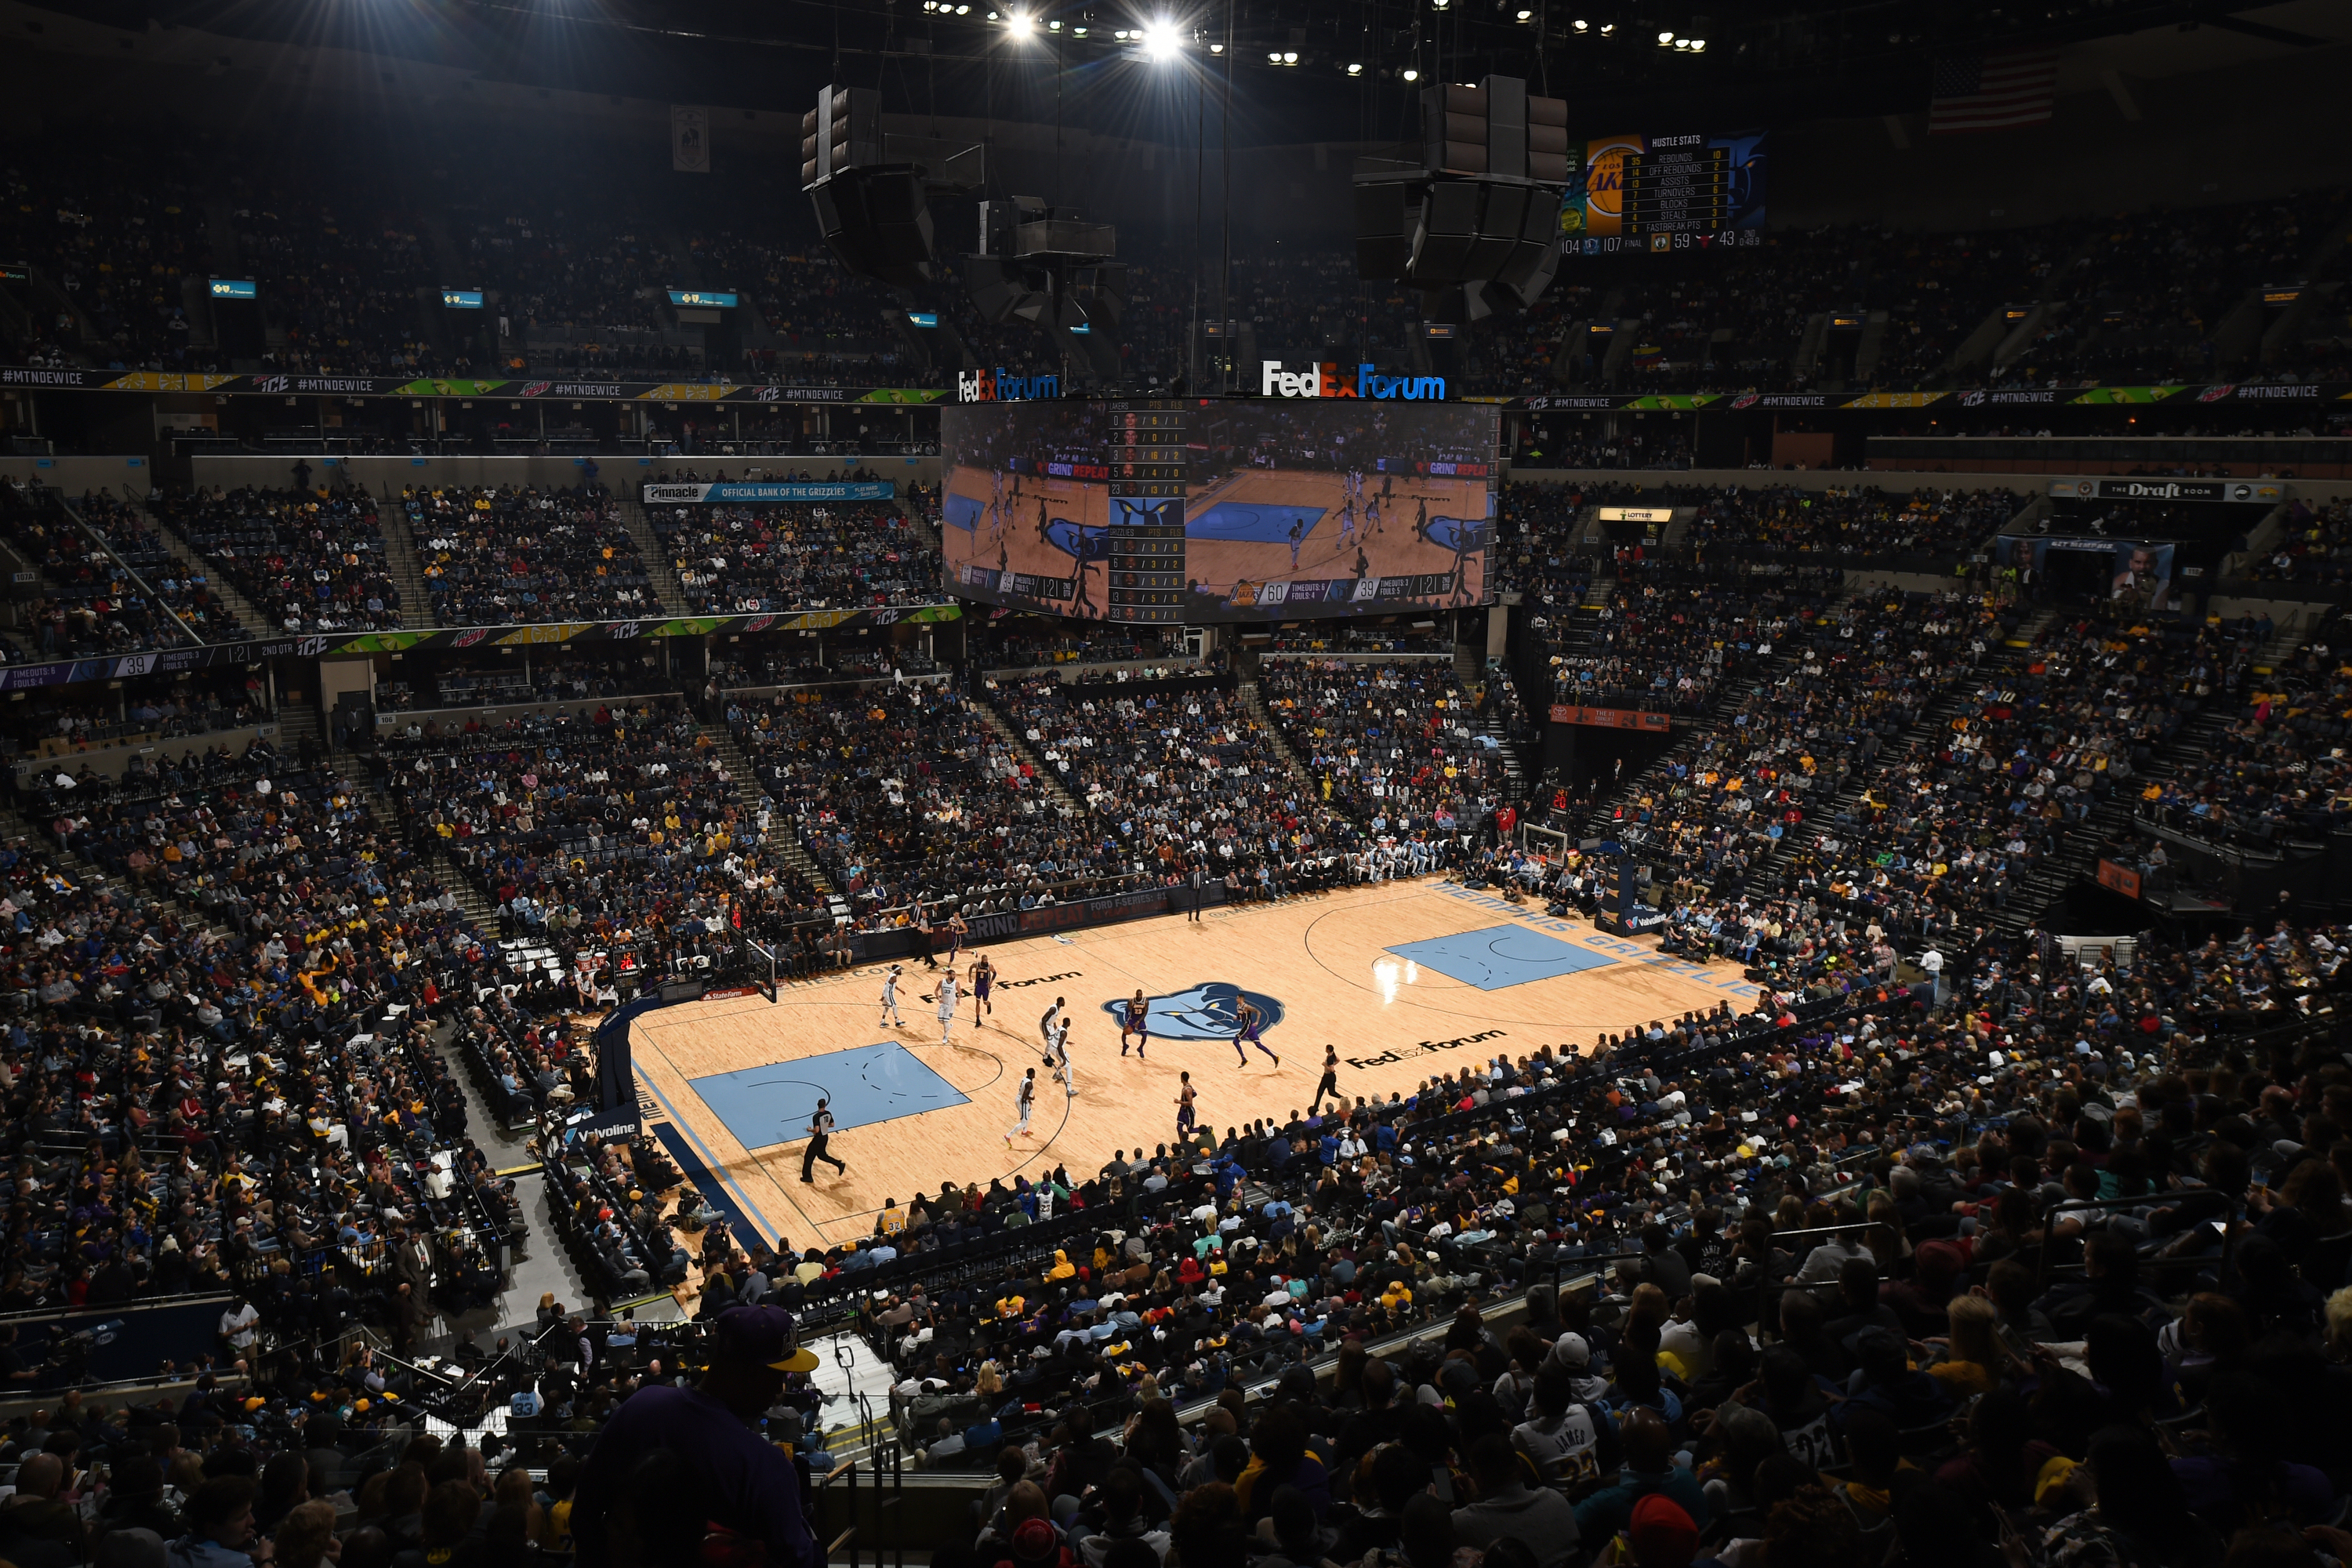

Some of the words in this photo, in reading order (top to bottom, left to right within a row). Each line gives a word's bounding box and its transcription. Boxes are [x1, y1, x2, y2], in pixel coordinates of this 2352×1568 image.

[1652, 137, 1678, 147] HUSTLE
[1679, 135, 1700, 145] STATS
[1632, 157, 1641, 165] 35
[1659, 153, 1693, 164] REBOUNDS
[1713, 151, 1721, 159] 10
[1632, 169, 1639, 177] 14
[1650, 166, 1664, 176] OFF
[1664, 164, 1701, 174] REBOUNDS
[1714, 162, 1719, 171] 2
[1632, 180, 1639, 188] 13
[1661, 176, 1690, 186] ASSISTS
[1714, 174, 1719, 183] 8
[1654, 187, 1695, 198] TURNOVERS
[1633, 202, 1637, 211] 2
[1660, 199, 1688, 209] BLOCKS
[1632, 213, 1637, 222] 4
[1661, 211, 1686, 220] STEALS
[1712, 209, 1717, 217] 3
[1632, 224, 1637, 233] 6
[1646, 222, 1686, 233] FASTBREAK
[1686, 220, 1700, 230] PTS
[1562, 240, 1580, 254] 104
[1603, 238, 1621, 252] 107
[1624, 239, 1642, 248] FINAL
[1675, 234, 1690, 249] 59
[1719, 231, 1734, 245] 43
[2, 370, 83, 385] #MTNDEWICE
[1262, 361, 1445, 401] FedExForum
[297, 379, 372, 391] #MTNDEWICE
[555, 384, 621, 396] #MTNDEWICE
[958, 367, 1057, 402] FedExForum
[786, 389, 843, 400] #MTNDEWICE
[1991, 392, 2054, 403] #MTNDEWICE
[2238, 386, 2318, 398] #MTNDEWICE
[1109, 401, 1129, 410] LAKERS
[1149, 401, 1161, 410] PTS
[1171, 401, 1182, 410] FLS
[1554, 397, 1610, 408] #MTNDEWICE
[1762, 396, 1825, 406] #MTNDEWICE
[1113, 416, 1118, 426] 0
[1113, 433, 1118, 443] 2
[1113, 450, 1118, 460] 3
[1048, 462, 1073, 477] GRIND
[1073, 464, 1109, 479] REPEAT
[1113, 467, 1118, 477] 5
[1430, 461, 1456, 474] GRIND
[1457, 463, 1487, 477] REPEAT
[651, 486, 699, 499] Pinnacle
[721, 488, 756, 498] OFFICIAL
[757, 488, 779, 497] BANK
[780, 488, 789, 496] OF
[792, 487, 807, 496] THE
[808, 487, 845, 496] GRIZZLIES
[1112, 484, 1120, 495] 23
[2129, 482, 2181, 498] Draft
[1109, 527, 1134, 537] GRIZZLIES
[1149, 528, 1160, 537] PTS
[1170, 528, 1181, 536] FLS
[1113, 541, 1118, 551] 0
[1113, 558, 1118, 568] 6
[16, 572, 34, 582] 107A
[1113, 575, 1118, 585] 11
[1003, 574, 1011, 590] 39
[1043, 579, 1058, 597] 1:21
[1268, 585, 1283, 601] 60
[1360, 581, 1374, 597] 39
[1419, 576, 1436, 593] 1:21
[1292, 583, 1320, 592] TIMEOUTS:
[1381, 579, 1404, 588] TIMEOUTS:
[1112, 591, 1120, 601] 13
[1292, 591, 1311, 601] FOULS:
[1380, 587, 1396, 596] FOULS:
[1112, 608, 1120, 619] 33
[613, 622, 640, 639] ICE
[297, 637, 328, 656] ICE
[162, 652, 194, 662] TIMEOUTS:
[228, 645, 251, 663] 1:21
[262, 646, 278, 656] 2ND
[279, 644, 293, 654] QTR
[127, 657, 145, 673] 39
[162, 662, 183, 670] FOULS:
[13, 667, 49, 680] TIMEOUTS:
[13, 678, 38, 688] FOULS:
[38, 677, 43, 685] 4
[1553, 795, 1566, 808] 20
[1614, 810, 1621, 818] 20
[1425, 881, 1579, 933] MEMPHIS
[964, 915, 1018, 939] GRIND
[1020, 904, 1085, 929] REPEAT
[1091, 900, 1112, 911] FORD
[1115, 894, 1153, 907] F-SERIES:
[1156, 891, 1167, 900] #1
[1639, 913, 1666, 927] Valvoline
[620, 960, 633, 970] 20
[1345, 1029, 1508, 1069] FedExForum
[578, 1123, 635, 1142] Valvoline
[889, 1221, 901, 1231] 32
[1701, 1245, 1720, 1257] JAMES
[514, 1403, 533, 1416] 33
[1555, 1429, 1584, 1454] JAMES
